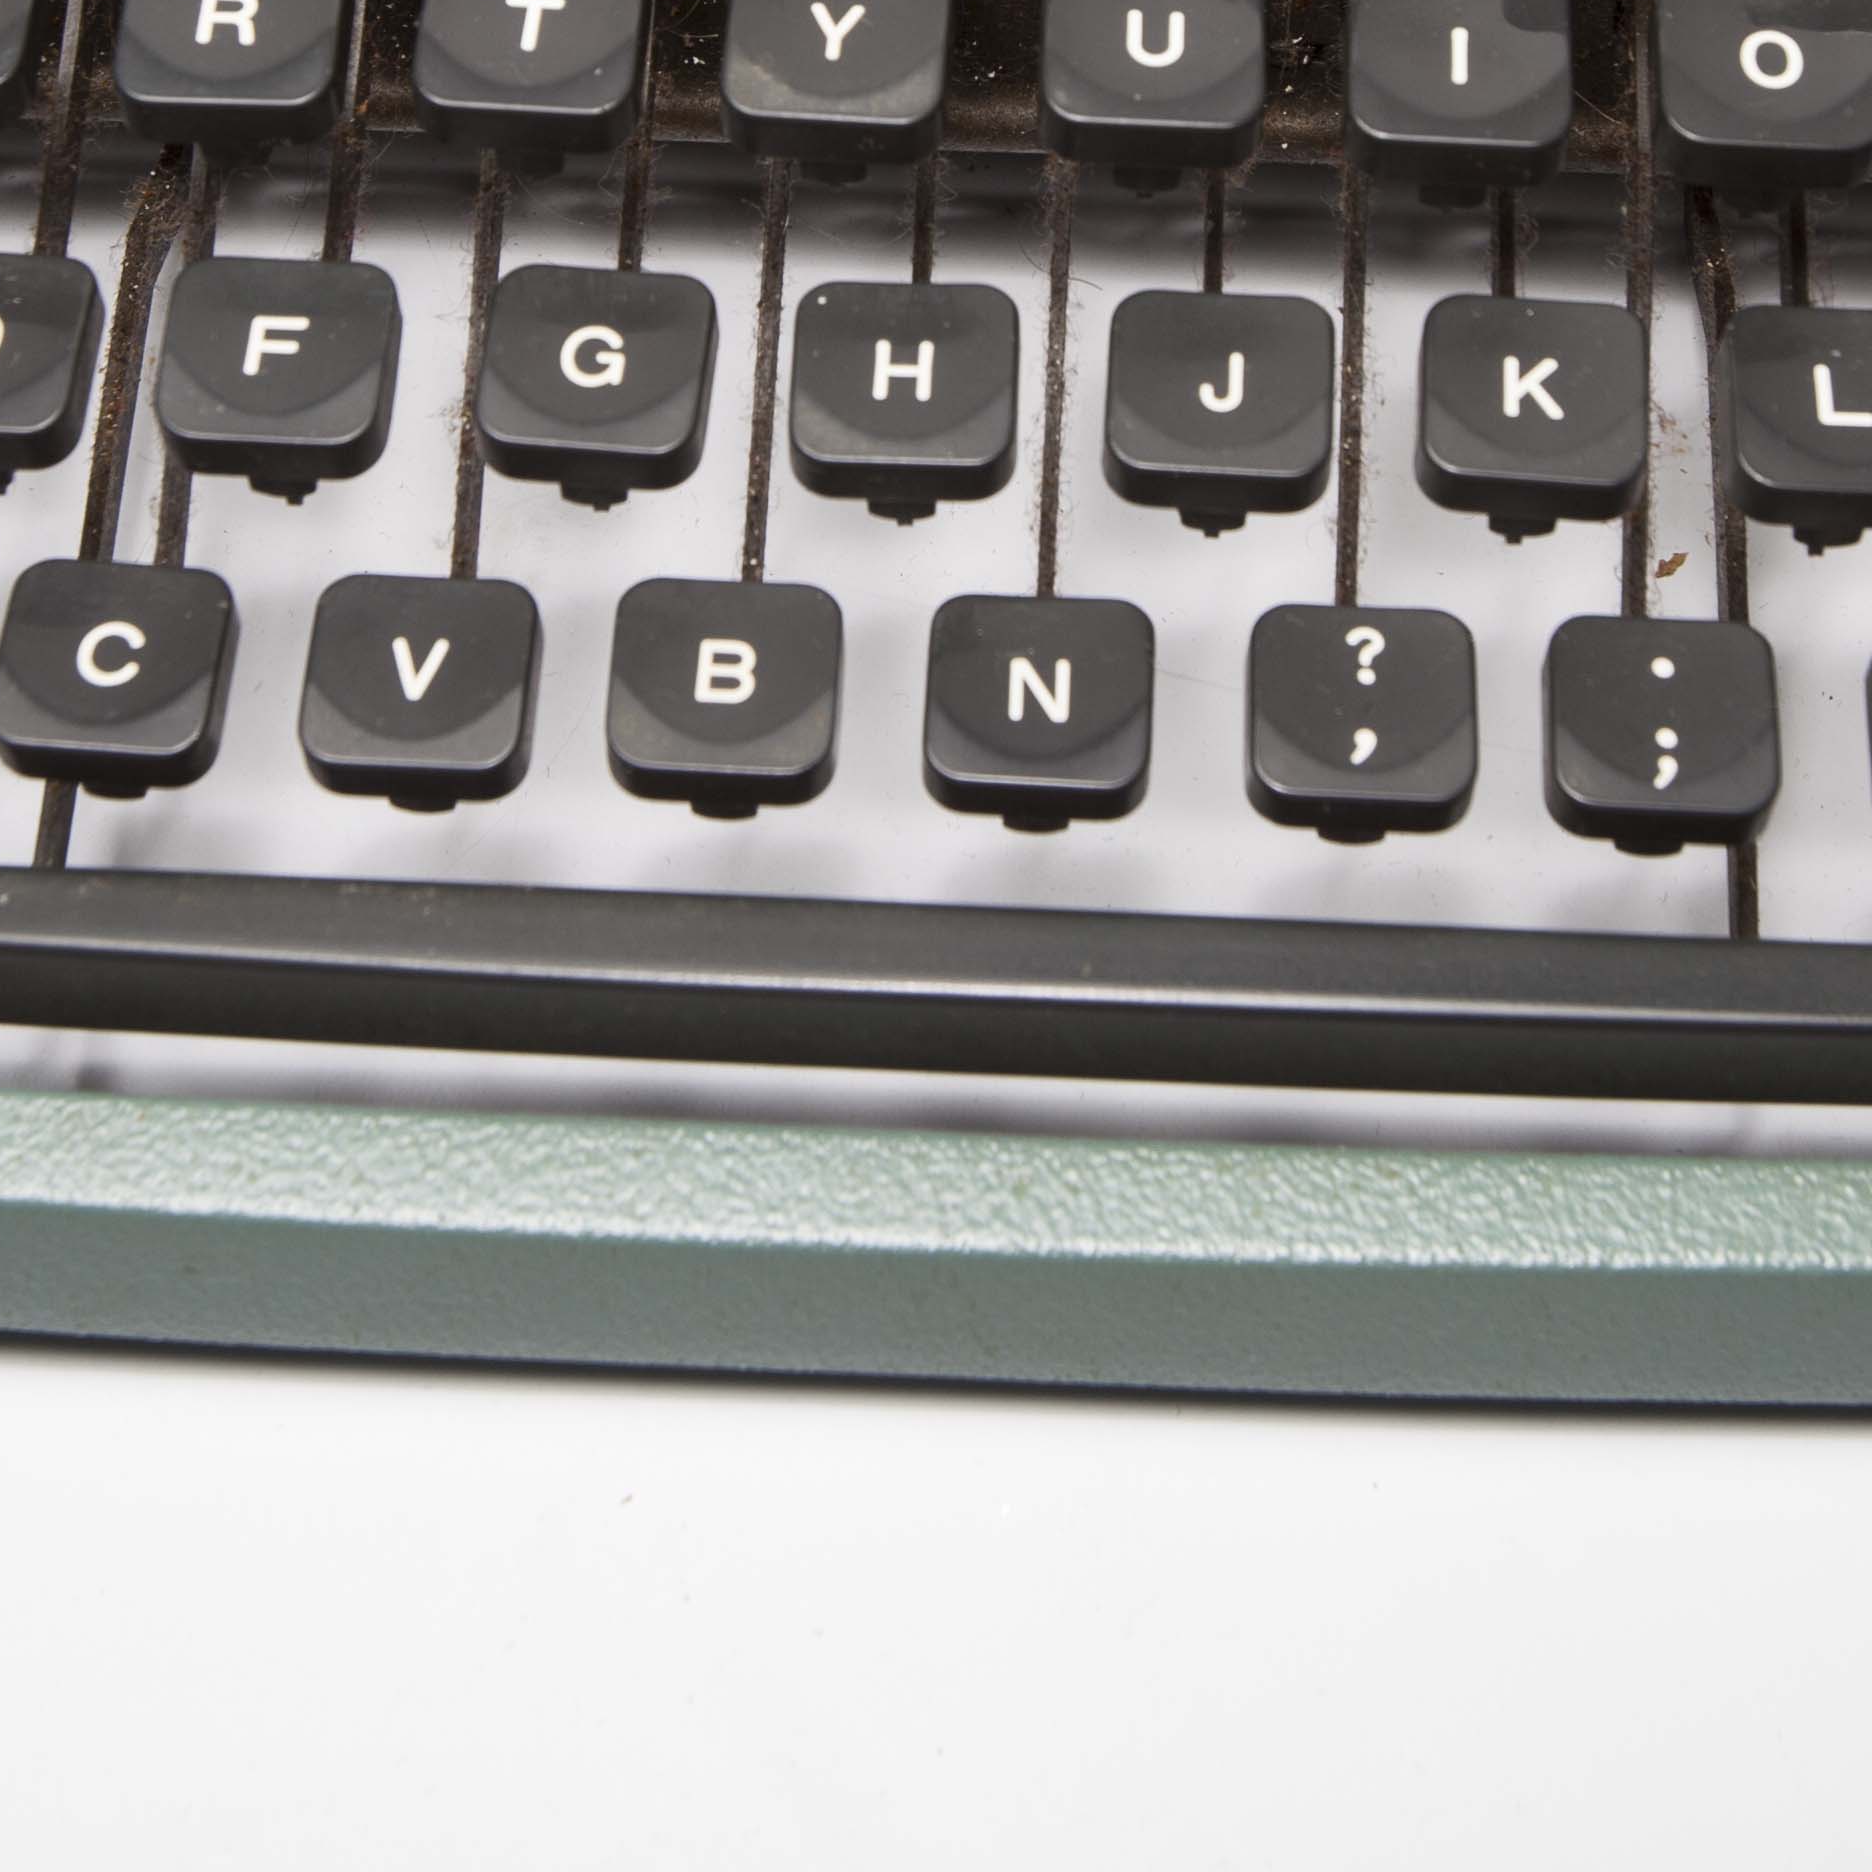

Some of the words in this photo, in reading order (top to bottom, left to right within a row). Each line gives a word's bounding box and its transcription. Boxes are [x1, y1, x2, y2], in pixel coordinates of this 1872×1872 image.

[810, 2, 866, 61] Y
[1125, 9, 1185, 68] U
[1450, 26, 1469, 85] I
[1739, 29, 1804, 90] O
[242, 315, 310, 376] F
[559, 325, 626, 388] G
[872, 339, 935, 402] H
[1198, 351, 1245, 413] J
[1503, 355, 1565, 420] K
[76, 621, 146, 687] C
[392, 636, 450, 701] V
[694, 638, 757, 704] B
[1345, 626, 1386, 686] ?
[1008, 657, 1071, 724] N
